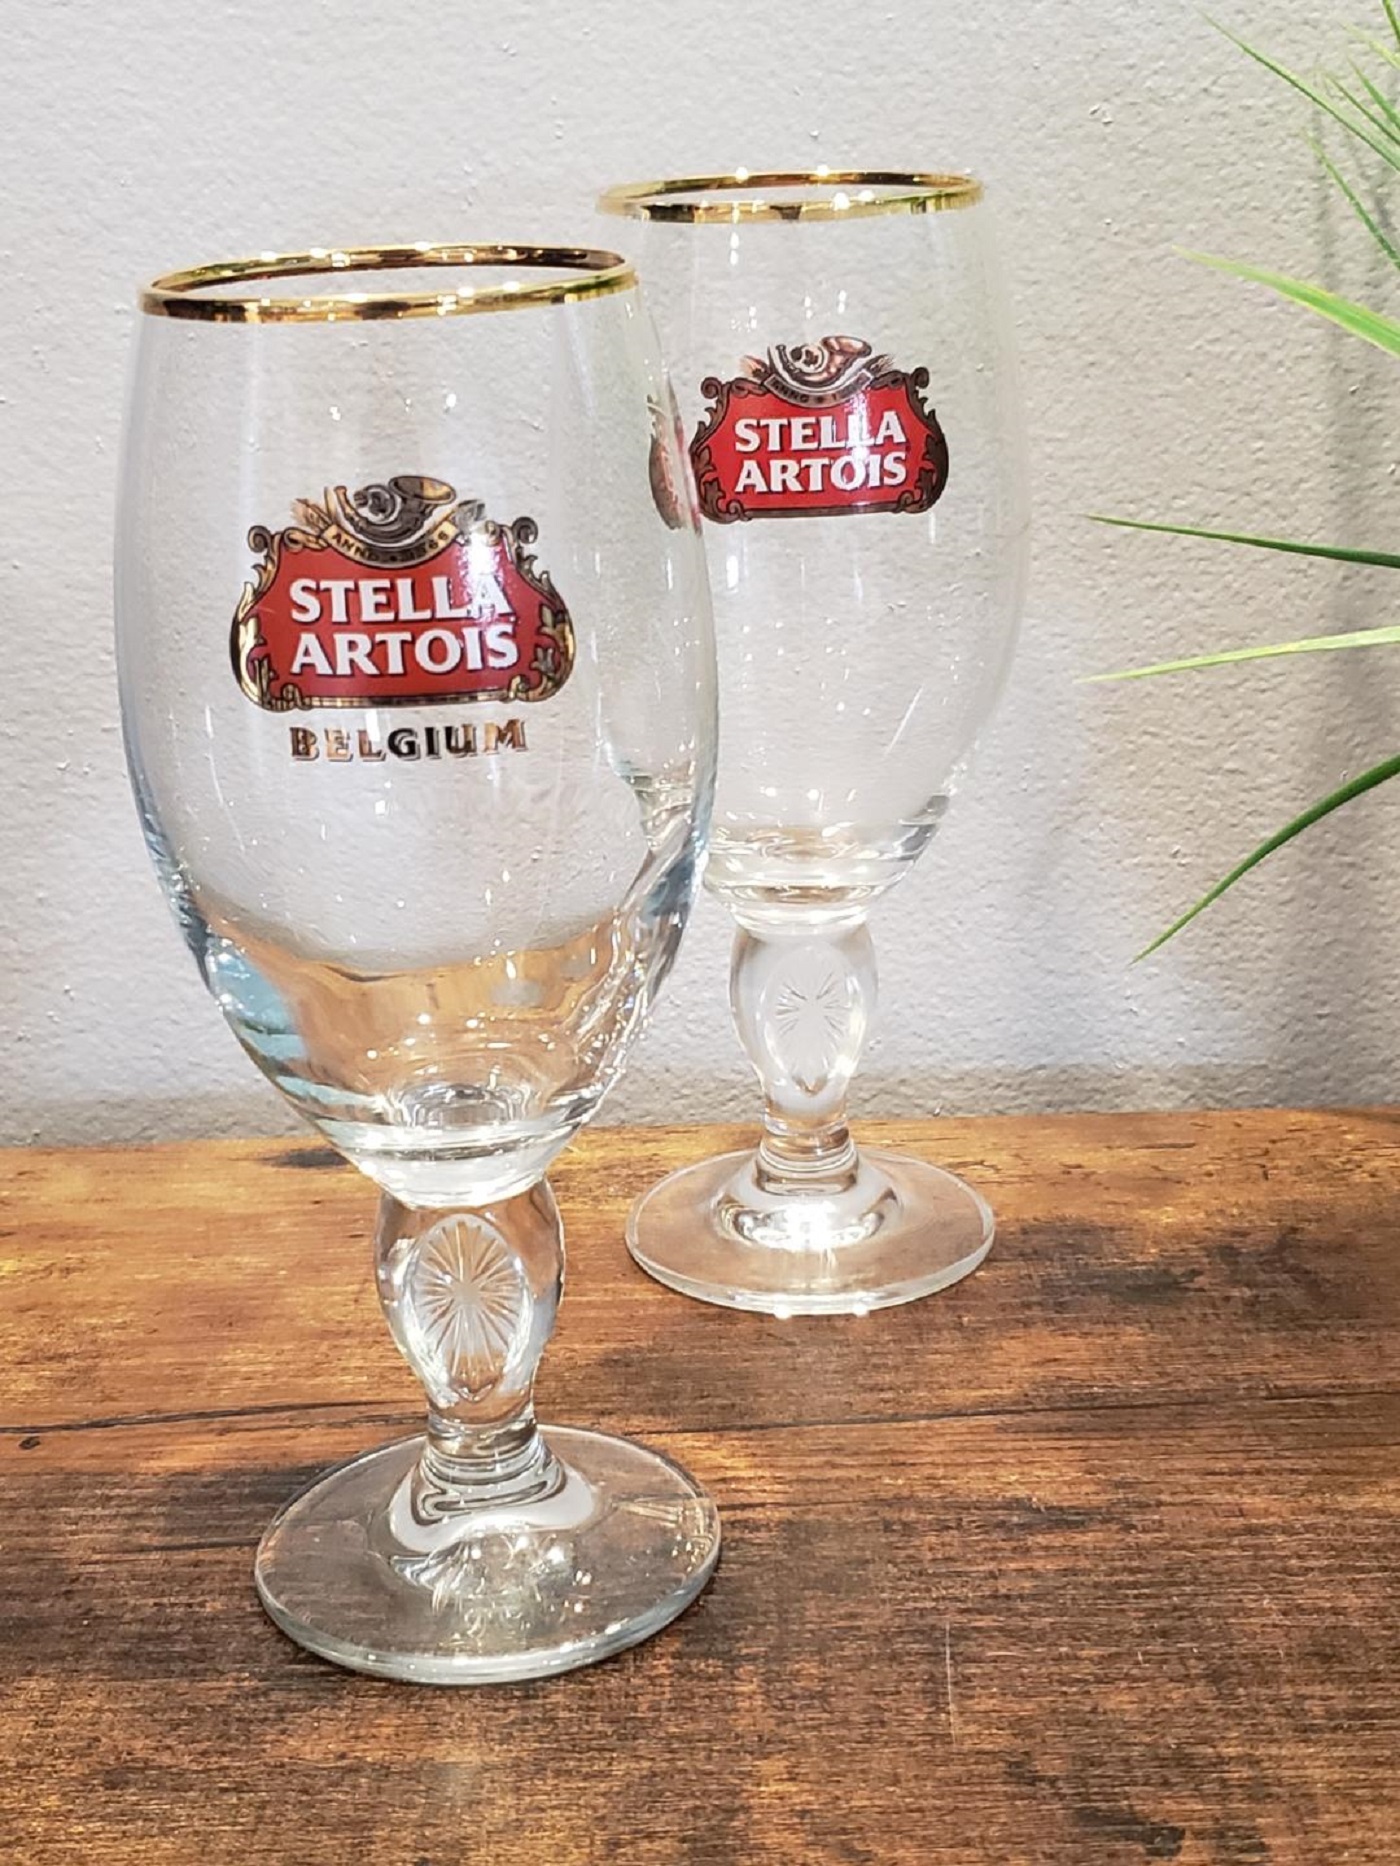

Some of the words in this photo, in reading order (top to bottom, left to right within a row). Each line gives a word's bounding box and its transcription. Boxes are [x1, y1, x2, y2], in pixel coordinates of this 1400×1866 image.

[734, 410, 907, 453] STELLA
[734, 451, 908, 493] ARTOIS
[289, 575, 515, 623] STELLA
[289, 623, 520, 676] ARTOIS
[289, 717, 528, 763] BELGIUM
